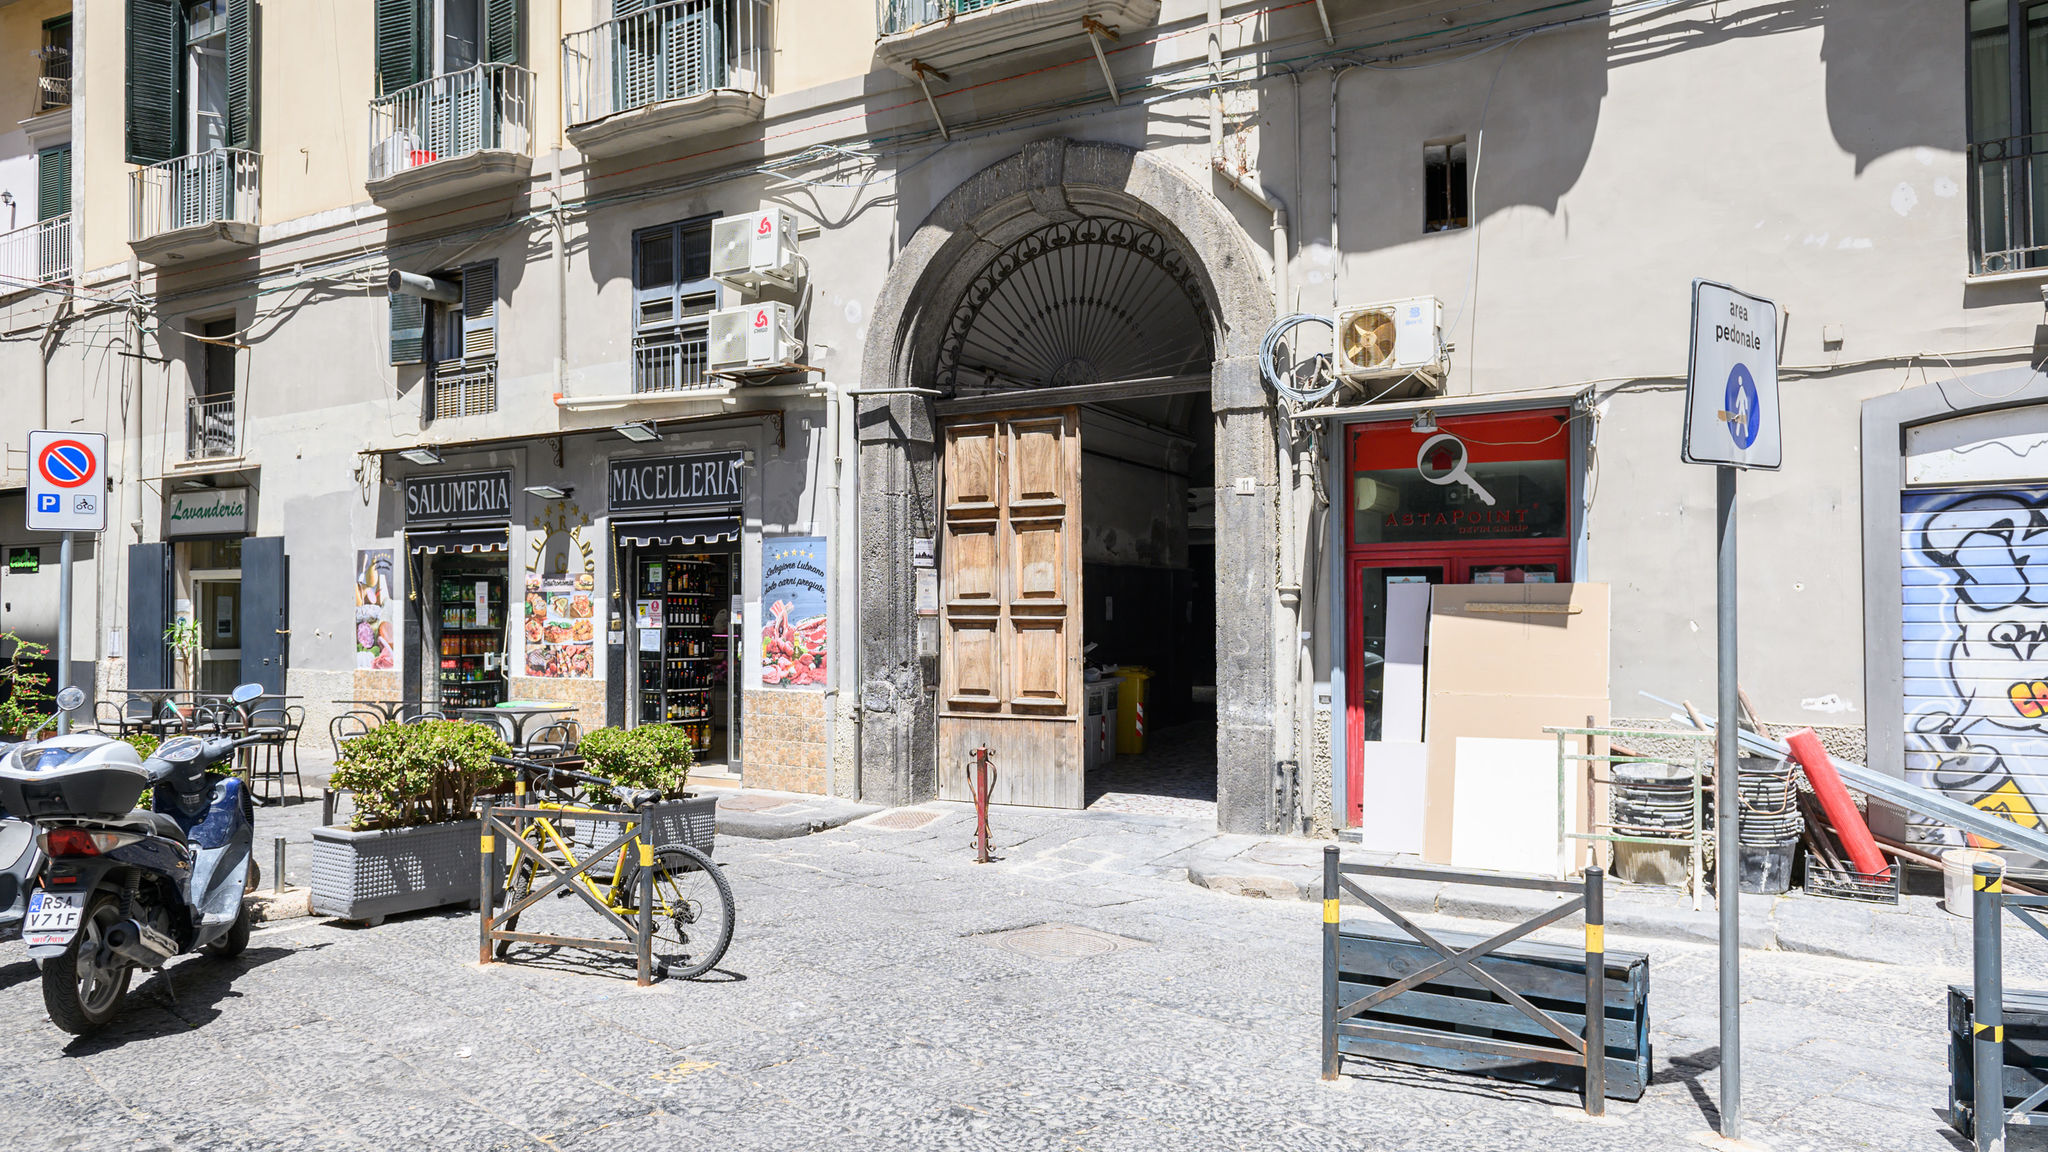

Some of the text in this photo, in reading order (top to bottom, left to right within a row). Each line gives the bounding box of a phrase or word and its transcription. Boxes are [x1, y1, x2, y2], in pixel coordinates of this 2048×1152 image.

[1729, 302, 1748, 321] area
[1715, 323, 1761, 350] pedonale
[612, 460, 739, 502] MACELLERIA
[1242, 480, 1249, 491] 11
[42, 496, 57, 511] P
[408, 478, 510, 515] SALUMERIA
[171, 498, 245, 521] Lavanderia
[1493, 524, 1529, 533] GROUP
[525, 514, 595, 574] LUBRANO
[765, 560, 825, 579] Selezione Lubrano
[778, 577, 797, 588] carni
[42, 896, 72, 910] RSA
[31, 912, 77, 927] V71F
